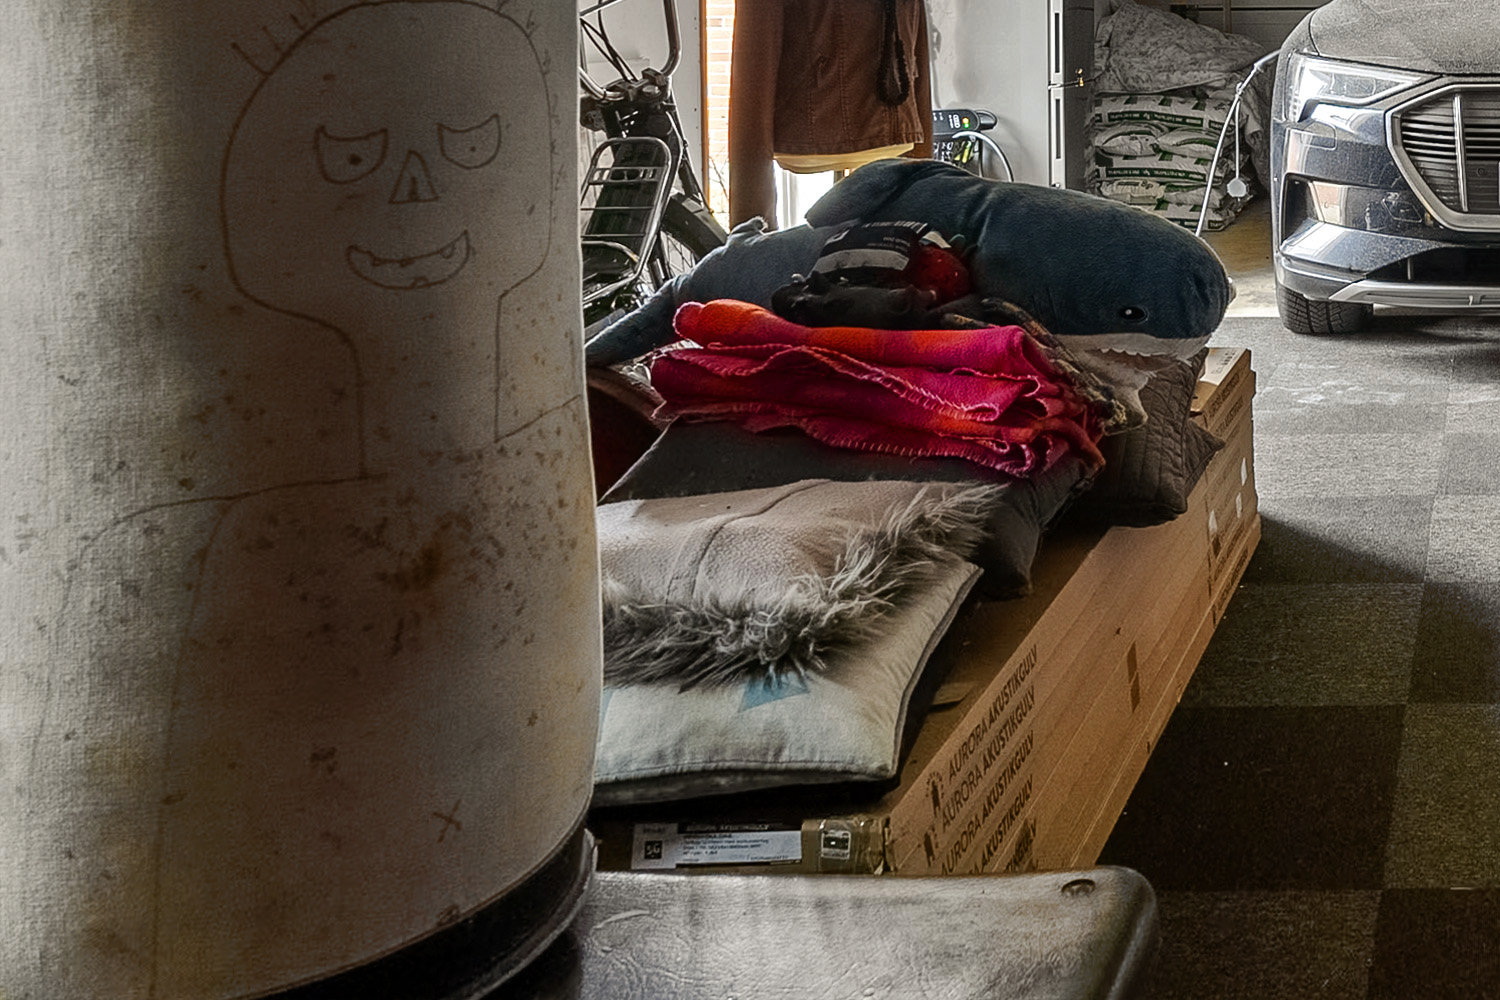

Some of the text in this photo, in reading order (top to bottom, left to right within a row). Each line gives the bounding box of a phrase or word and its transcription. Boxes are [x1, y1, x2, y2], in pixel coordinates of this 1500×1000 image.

[942, 685, 1036, 834] AURORA AKUSTIKGULV
[949, 644, 1038, 780] AURORA AKUSTIKGULV
[981, 729, 1035, 824] AKUSTIKGULV
